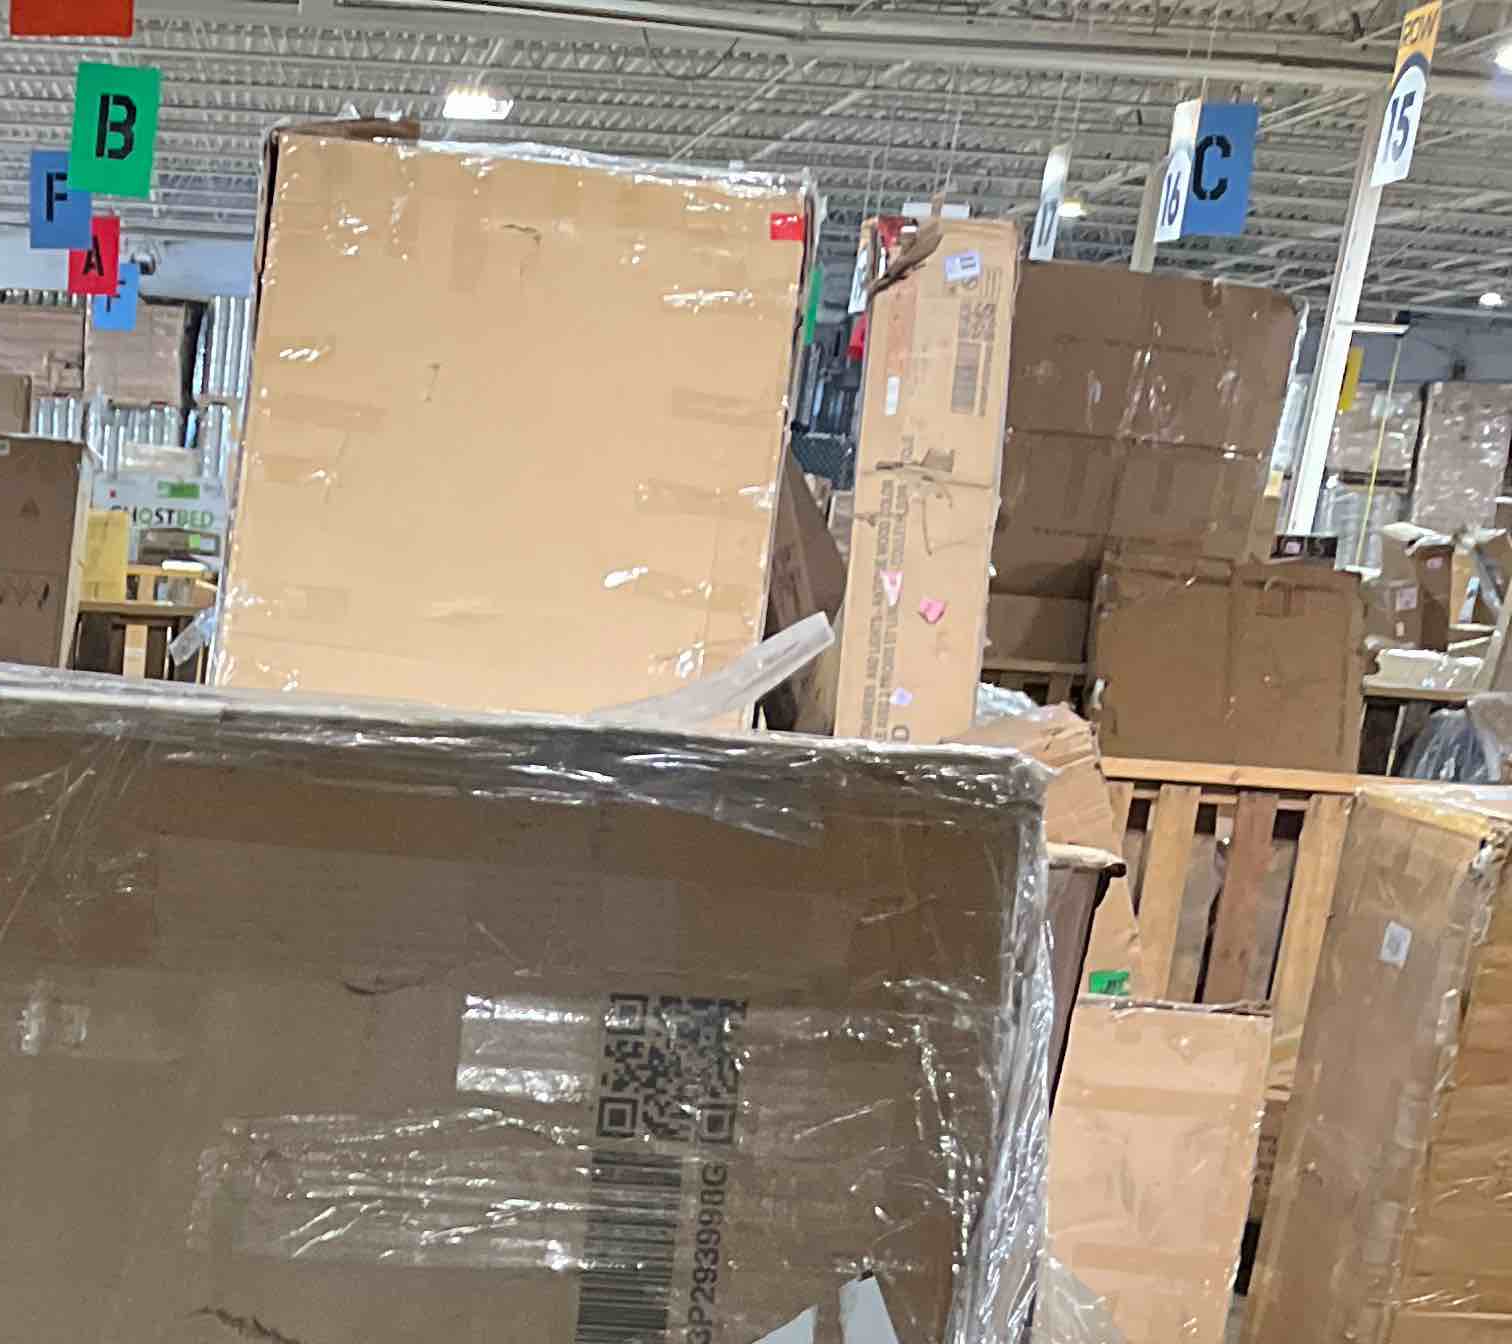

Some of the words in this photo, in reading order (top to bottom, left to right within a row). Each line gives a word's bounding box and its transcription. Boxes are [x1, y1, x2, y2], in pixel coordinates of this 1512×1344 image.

[95, 95, 136, 160] B
[1383, 90, 1417, 163] 15
[46, 172, 68, 223] F
[1193, 135, 1232, 201] C
[1161, 171, 1182, 227] 16
[82, 235, 105, 277] A
